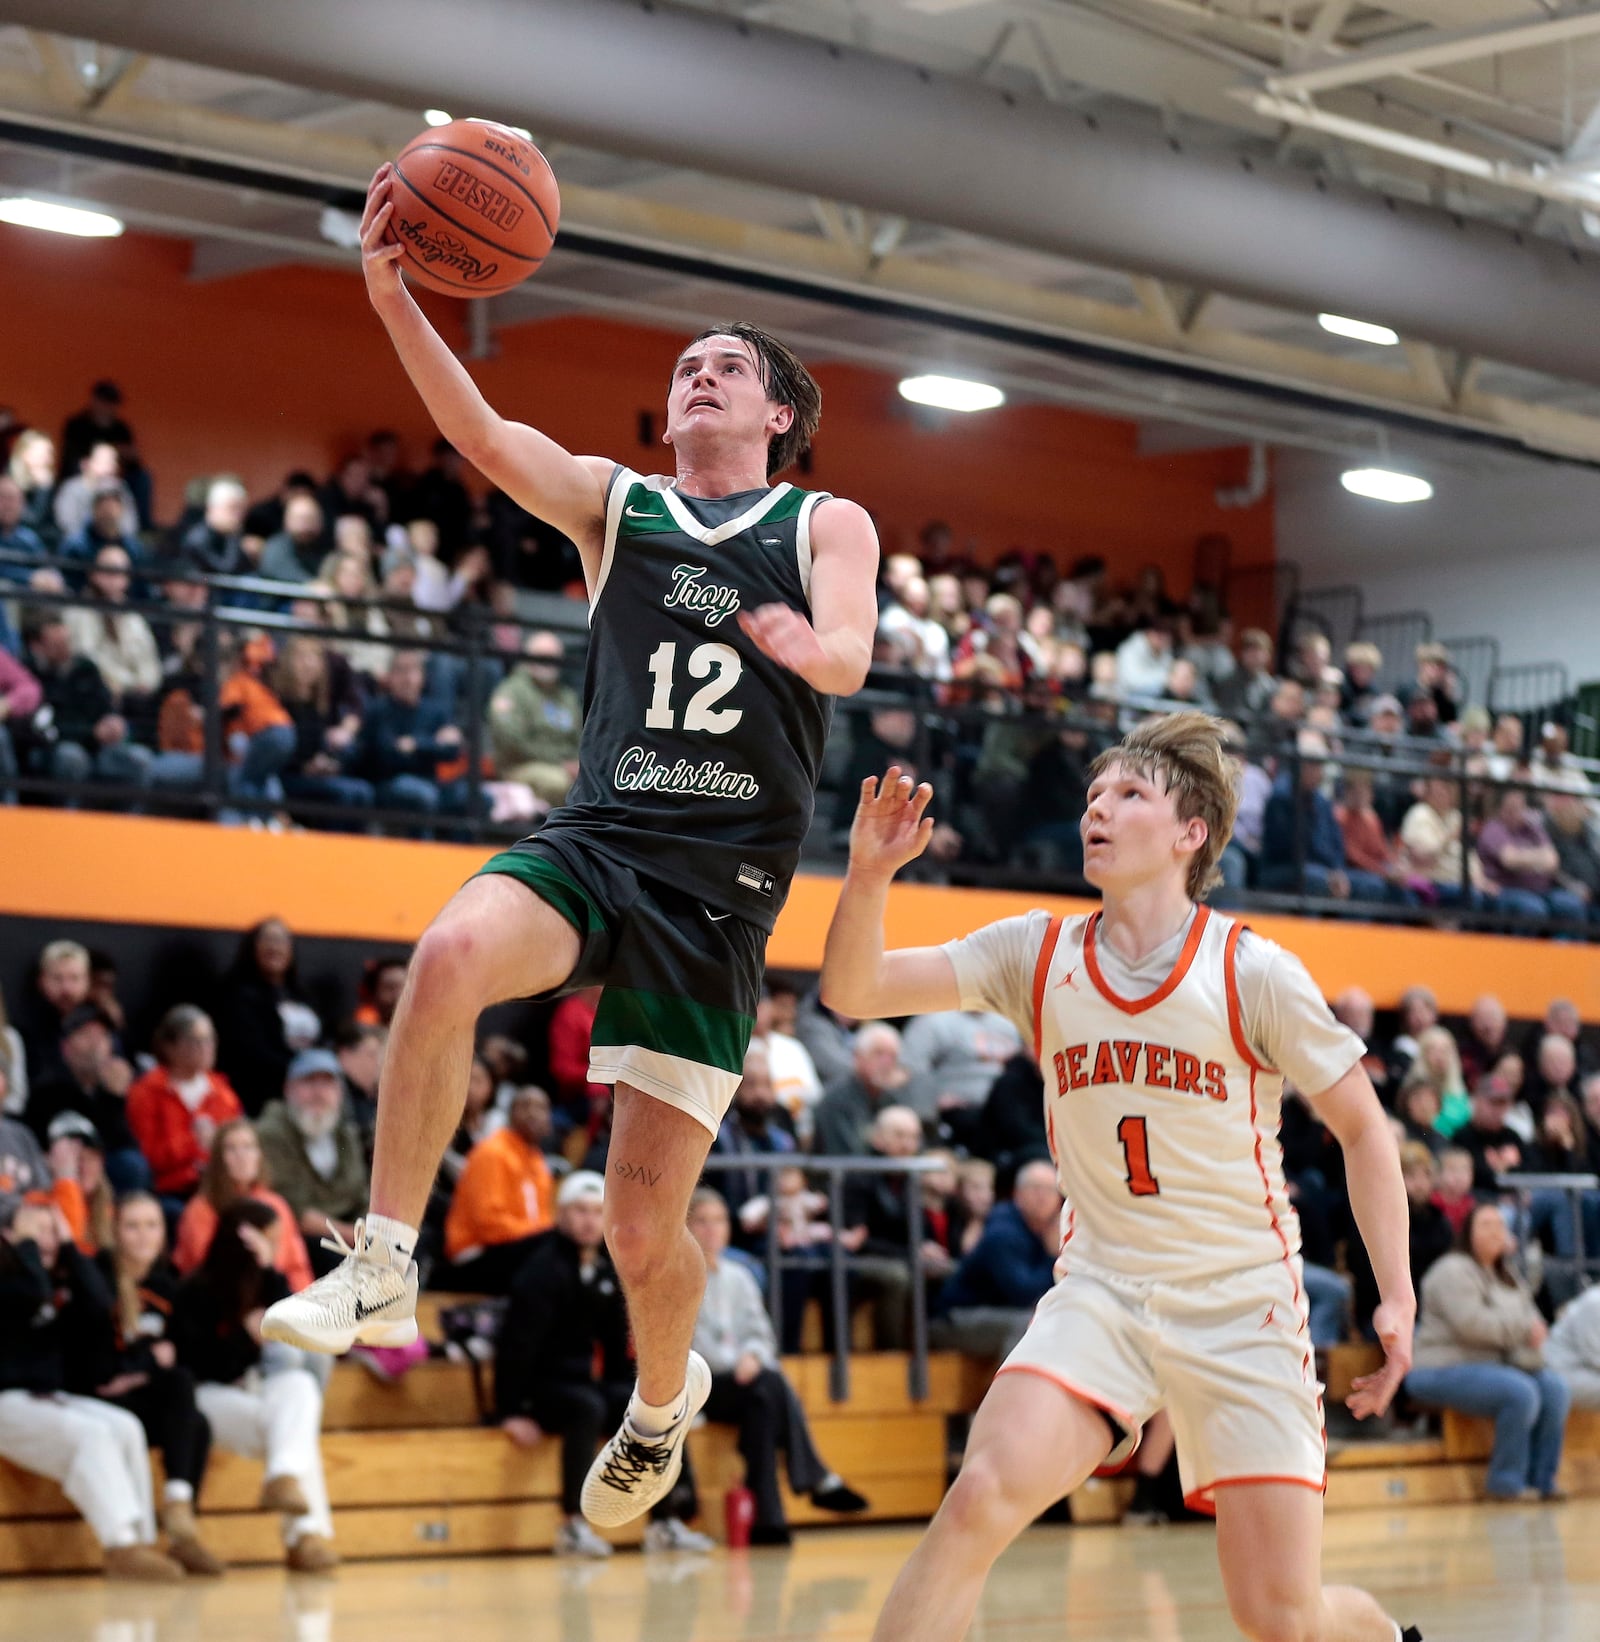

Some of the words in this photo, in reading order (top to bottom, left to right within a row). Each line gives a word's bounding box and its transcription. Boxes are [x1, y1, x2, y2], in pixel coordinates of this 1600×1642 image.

[433, 163, 523, 231] OHSAA
[399, 218, 498, 282] Rawlings
[664, 563, 741, 628] Troy
[644, 640, 744, 736] 12
[614, 745, 760, 800] Christian
[1053, 1040, 1228, 1103] BEAVERS
[1116, 1115, 1160, 1197] 1
